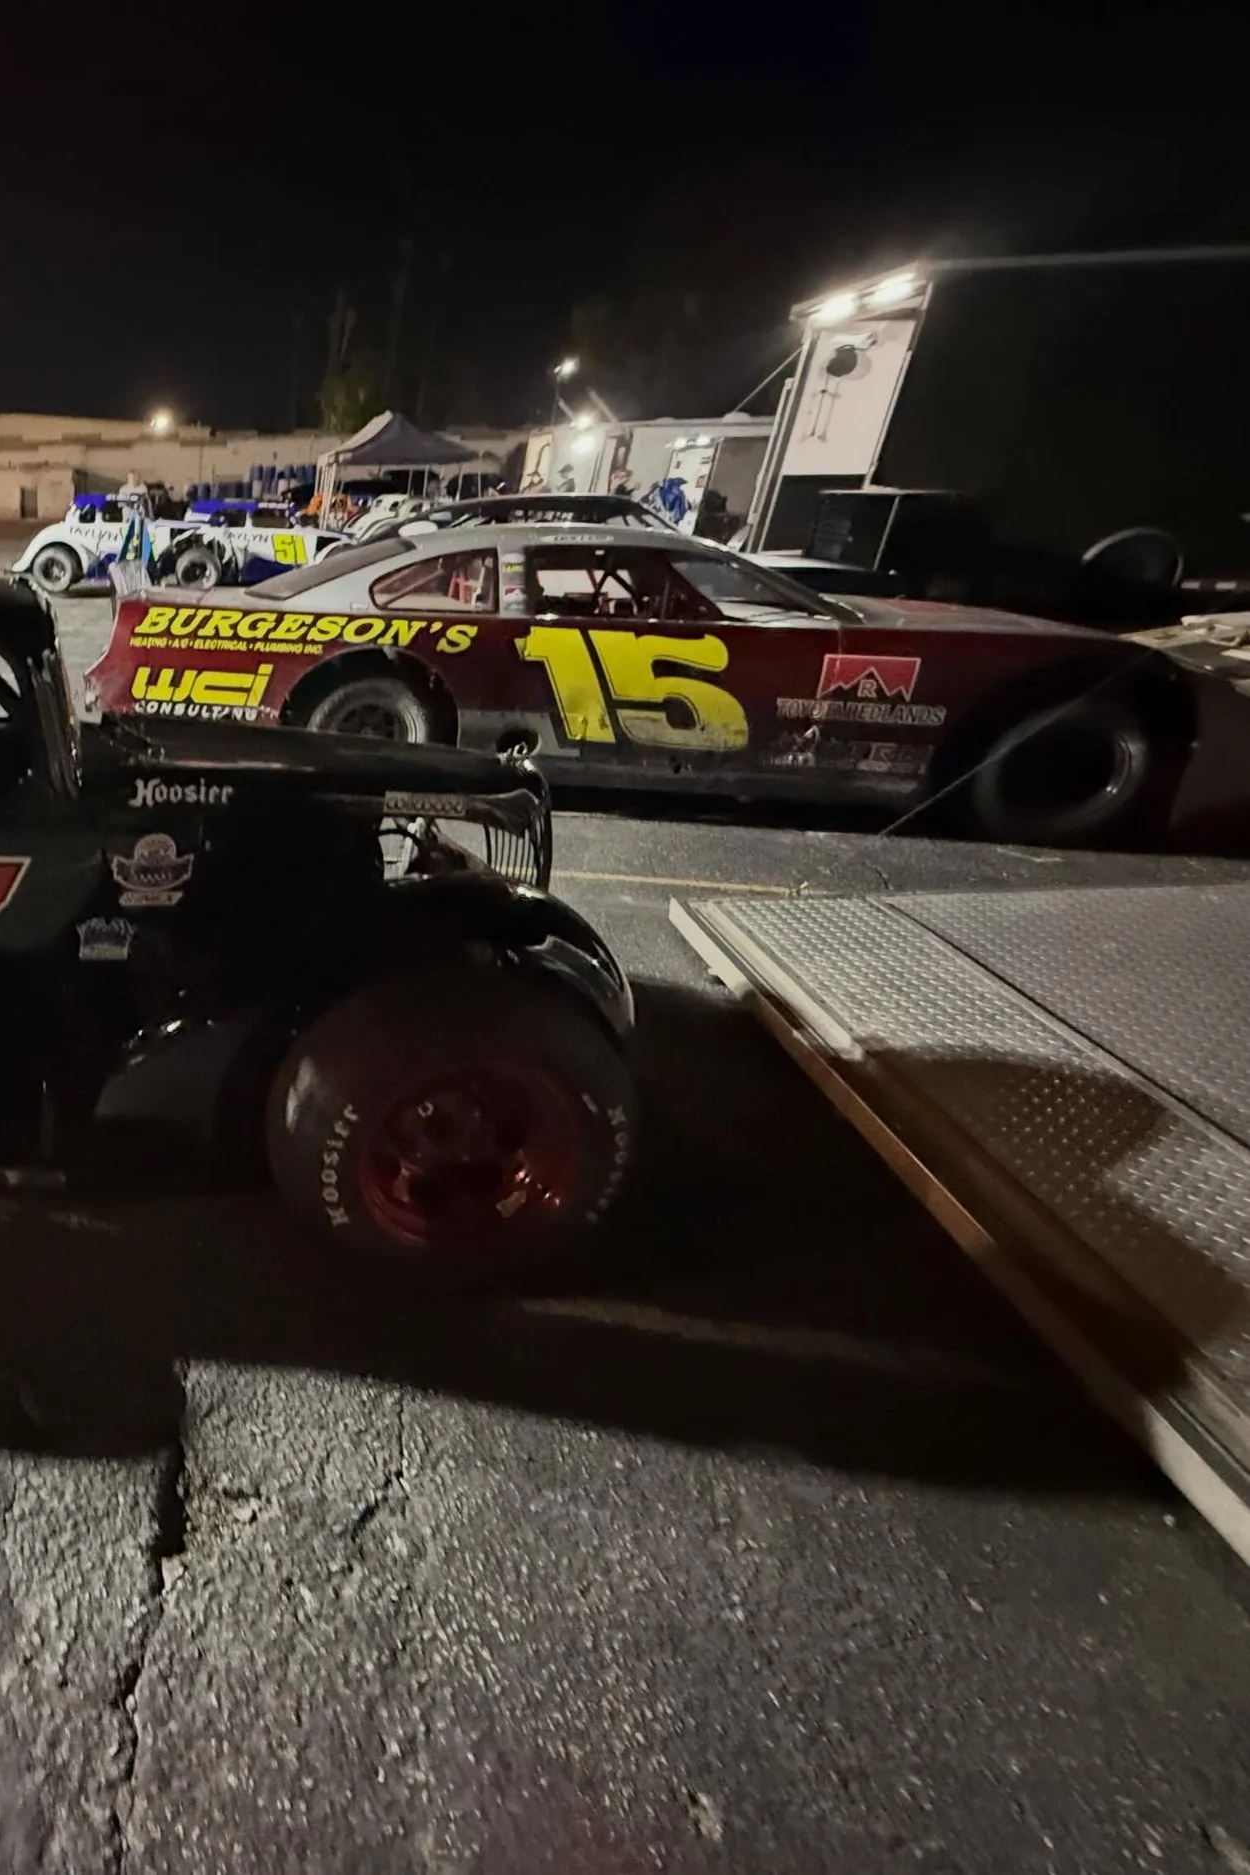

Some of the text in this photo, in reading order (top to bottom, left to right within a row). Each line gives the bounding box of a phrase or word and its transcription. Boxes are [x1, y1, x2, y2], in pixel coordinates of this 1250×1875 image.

[271, 533, 308, 566] 51
[134, 607, 478, 653] BURGESON'S
[193, 640, 248, 652] ELECTRICAL
[254, 643, 303, 655] PLUMBING
[514, 626, 748, 752] 15
[857, 679, 877, 698] R
[127, 777, 234, 809] Hoosier
